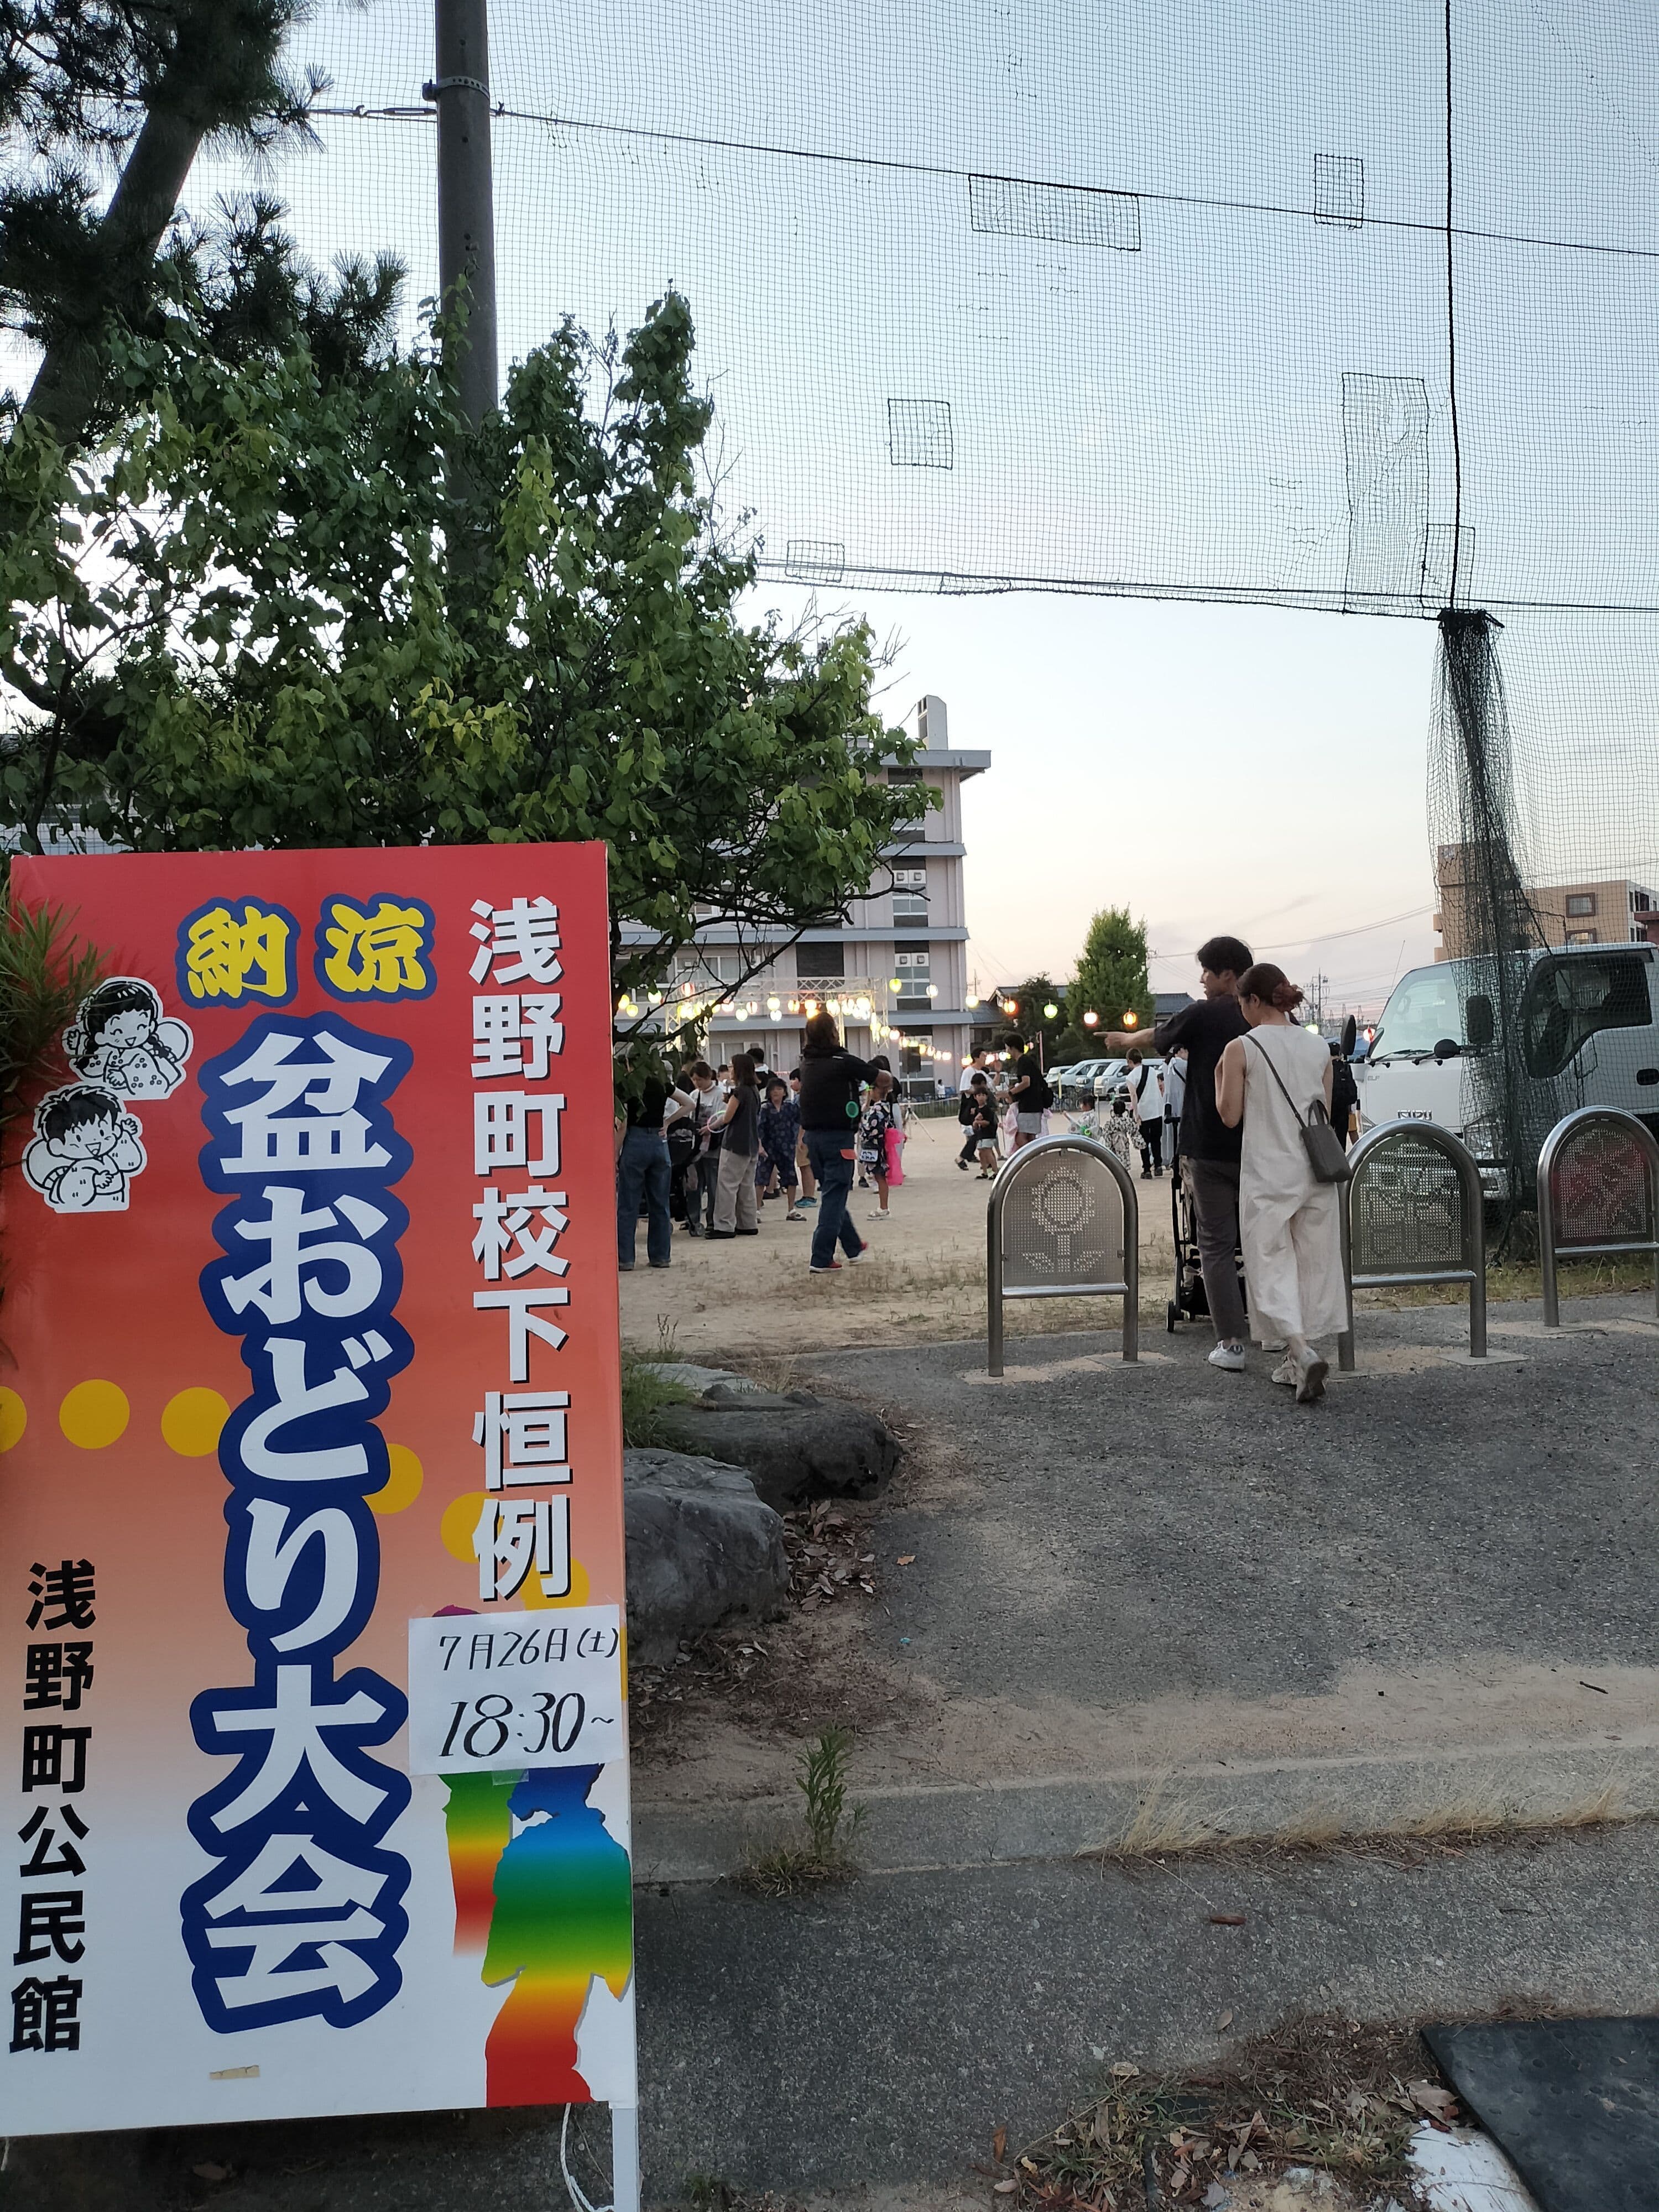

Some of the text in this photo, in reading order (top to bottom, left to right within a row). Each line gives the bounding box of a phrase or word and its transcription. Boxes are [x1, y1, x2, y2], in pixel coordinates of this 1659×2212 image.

[186, 902, 425, 999] 納涼
[469, 895, 572, 1601] 浅野町校下恒例
[204, 1030, 394, 2010] 盆おどり大会
[439, 1627, 619, 1671] 7月26日(土)
[9, 1558, 97, 2054] 浅野町公民館
